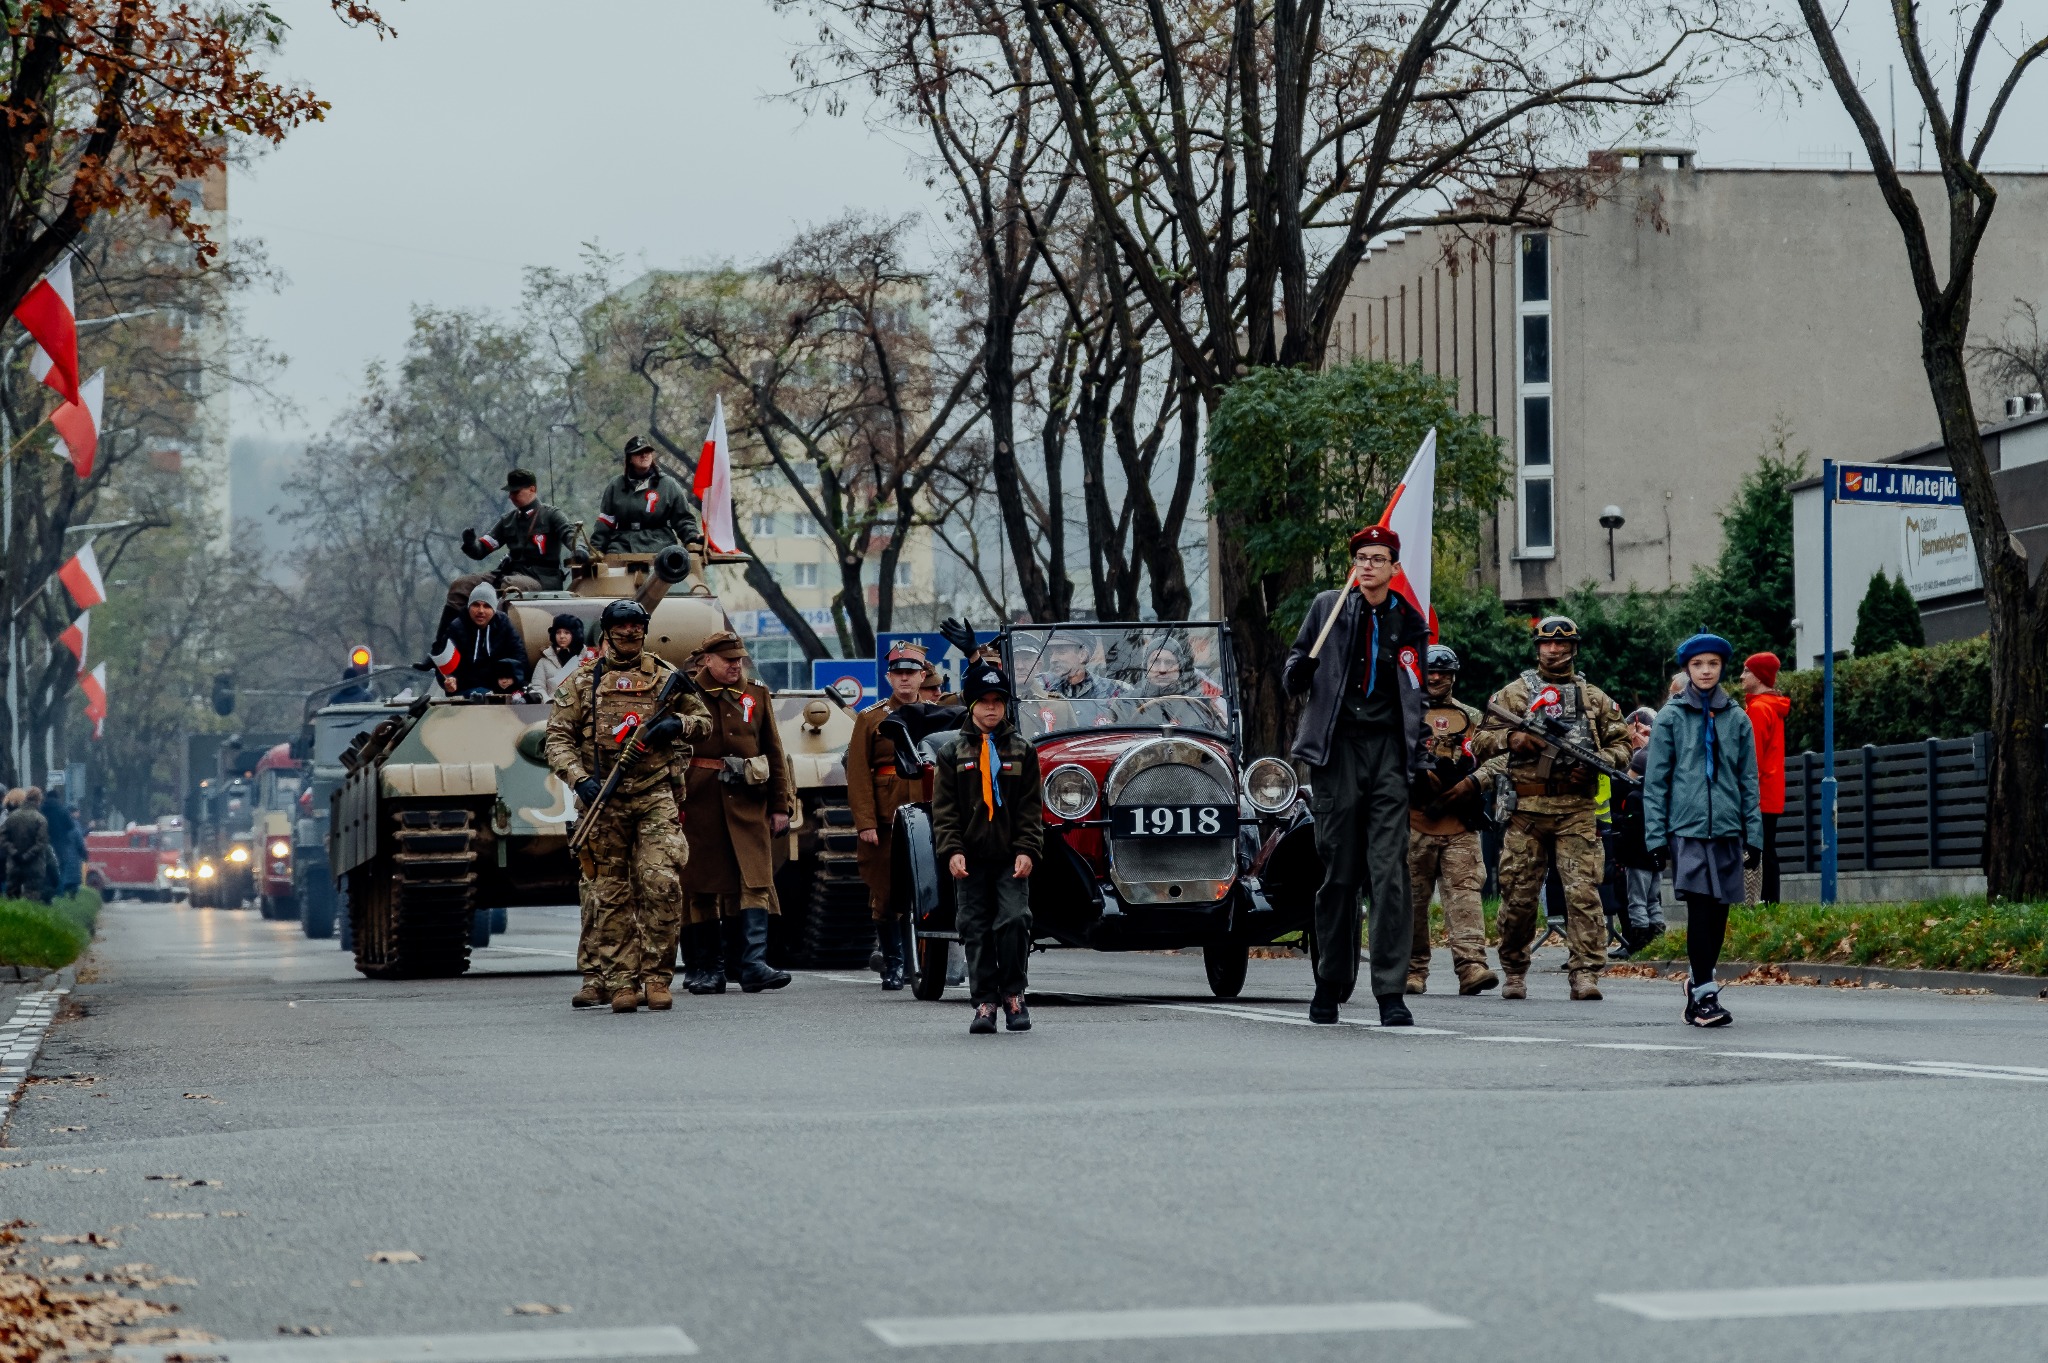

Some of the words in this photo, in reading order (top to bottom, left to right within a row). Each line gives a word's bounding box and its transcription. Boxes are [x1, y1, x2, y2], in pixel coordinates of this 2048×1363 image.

[1863, 473, 1882, 493] ul.
[1885, 473, 1899, 494] J.
[1901, 474, 1957, 501] Matejki
[1129, 807, 1221, 835] 1918
